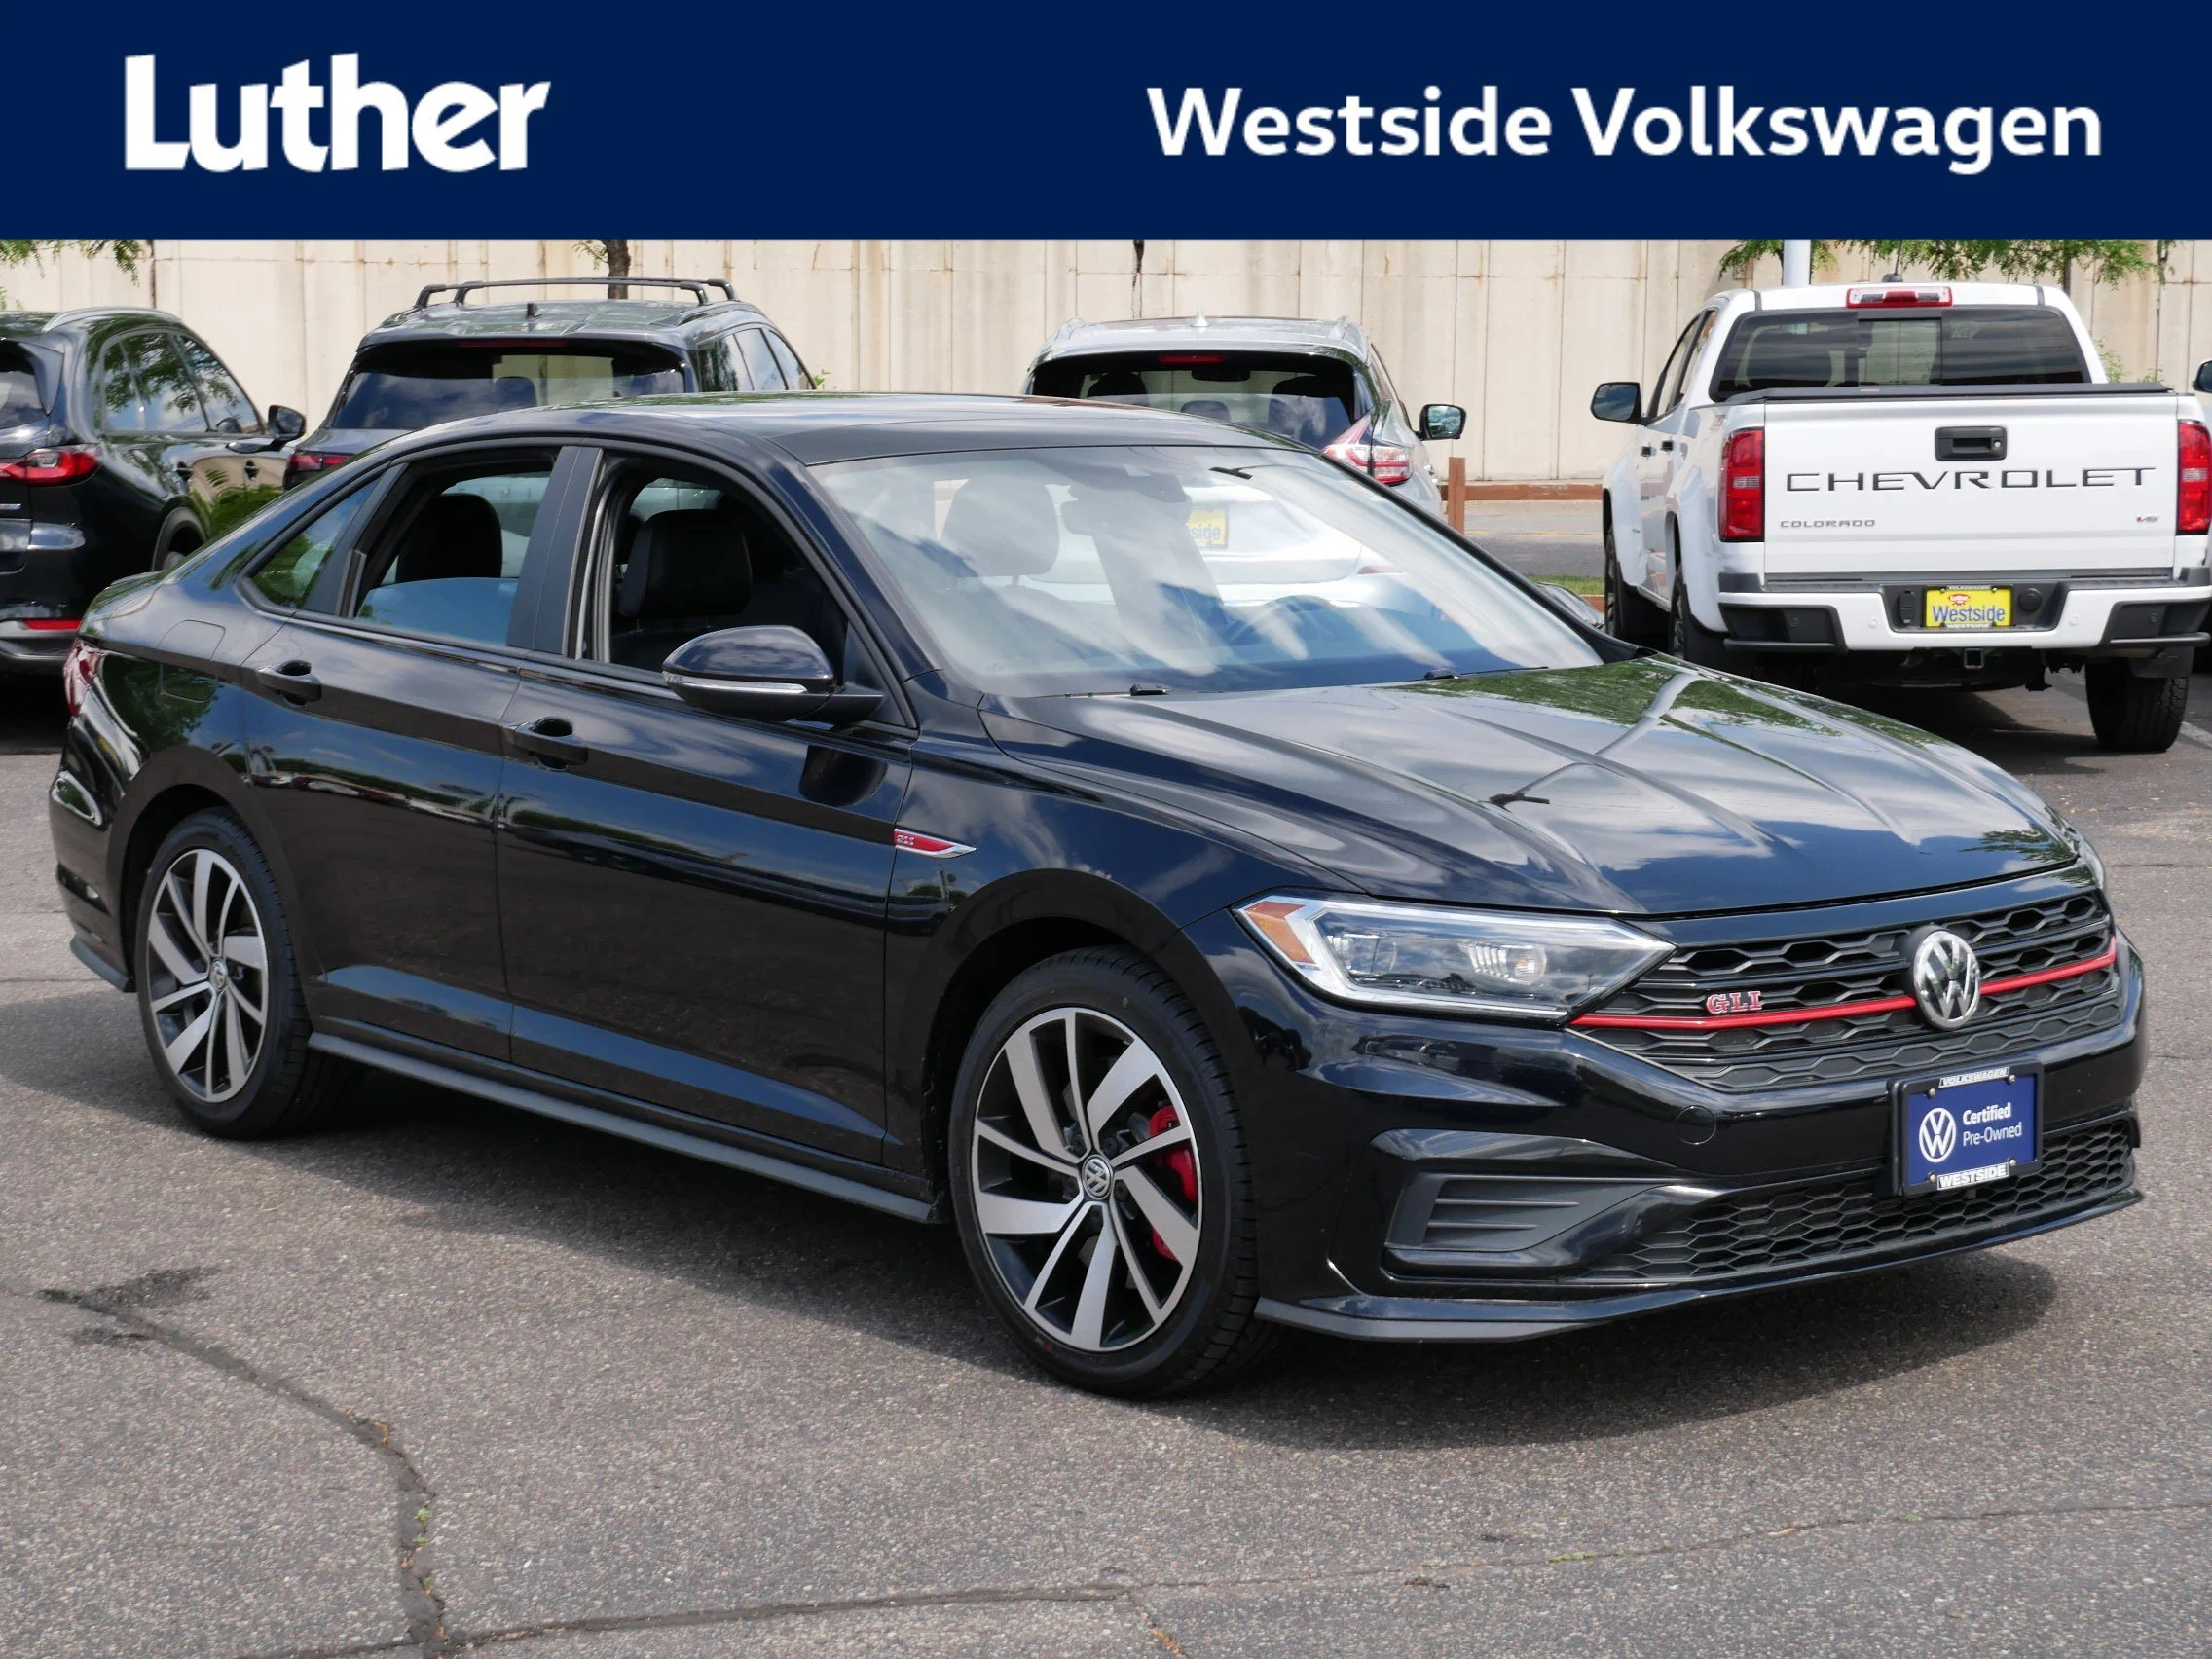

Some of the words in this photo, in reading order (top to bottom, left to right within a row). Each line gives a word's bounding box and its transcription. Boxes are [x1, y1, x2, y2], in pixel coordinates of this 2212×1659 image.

[1787, 467, 2156, 492] CHEVROLET
[1780, 518, 1876, 529] COLORADO
[1932, 605, 2006, 622] Westside
[1706, 990, 1762, 1014] GLI
[1941, 1068, 2008, 1086] VOLKSWAGEN
[1963, 1102, 2011, 1125] Certified
[1963, 1122, 2022, 1146] Pre-Owned
[1939, 1164, 2006, 1188] WESTSIDE
